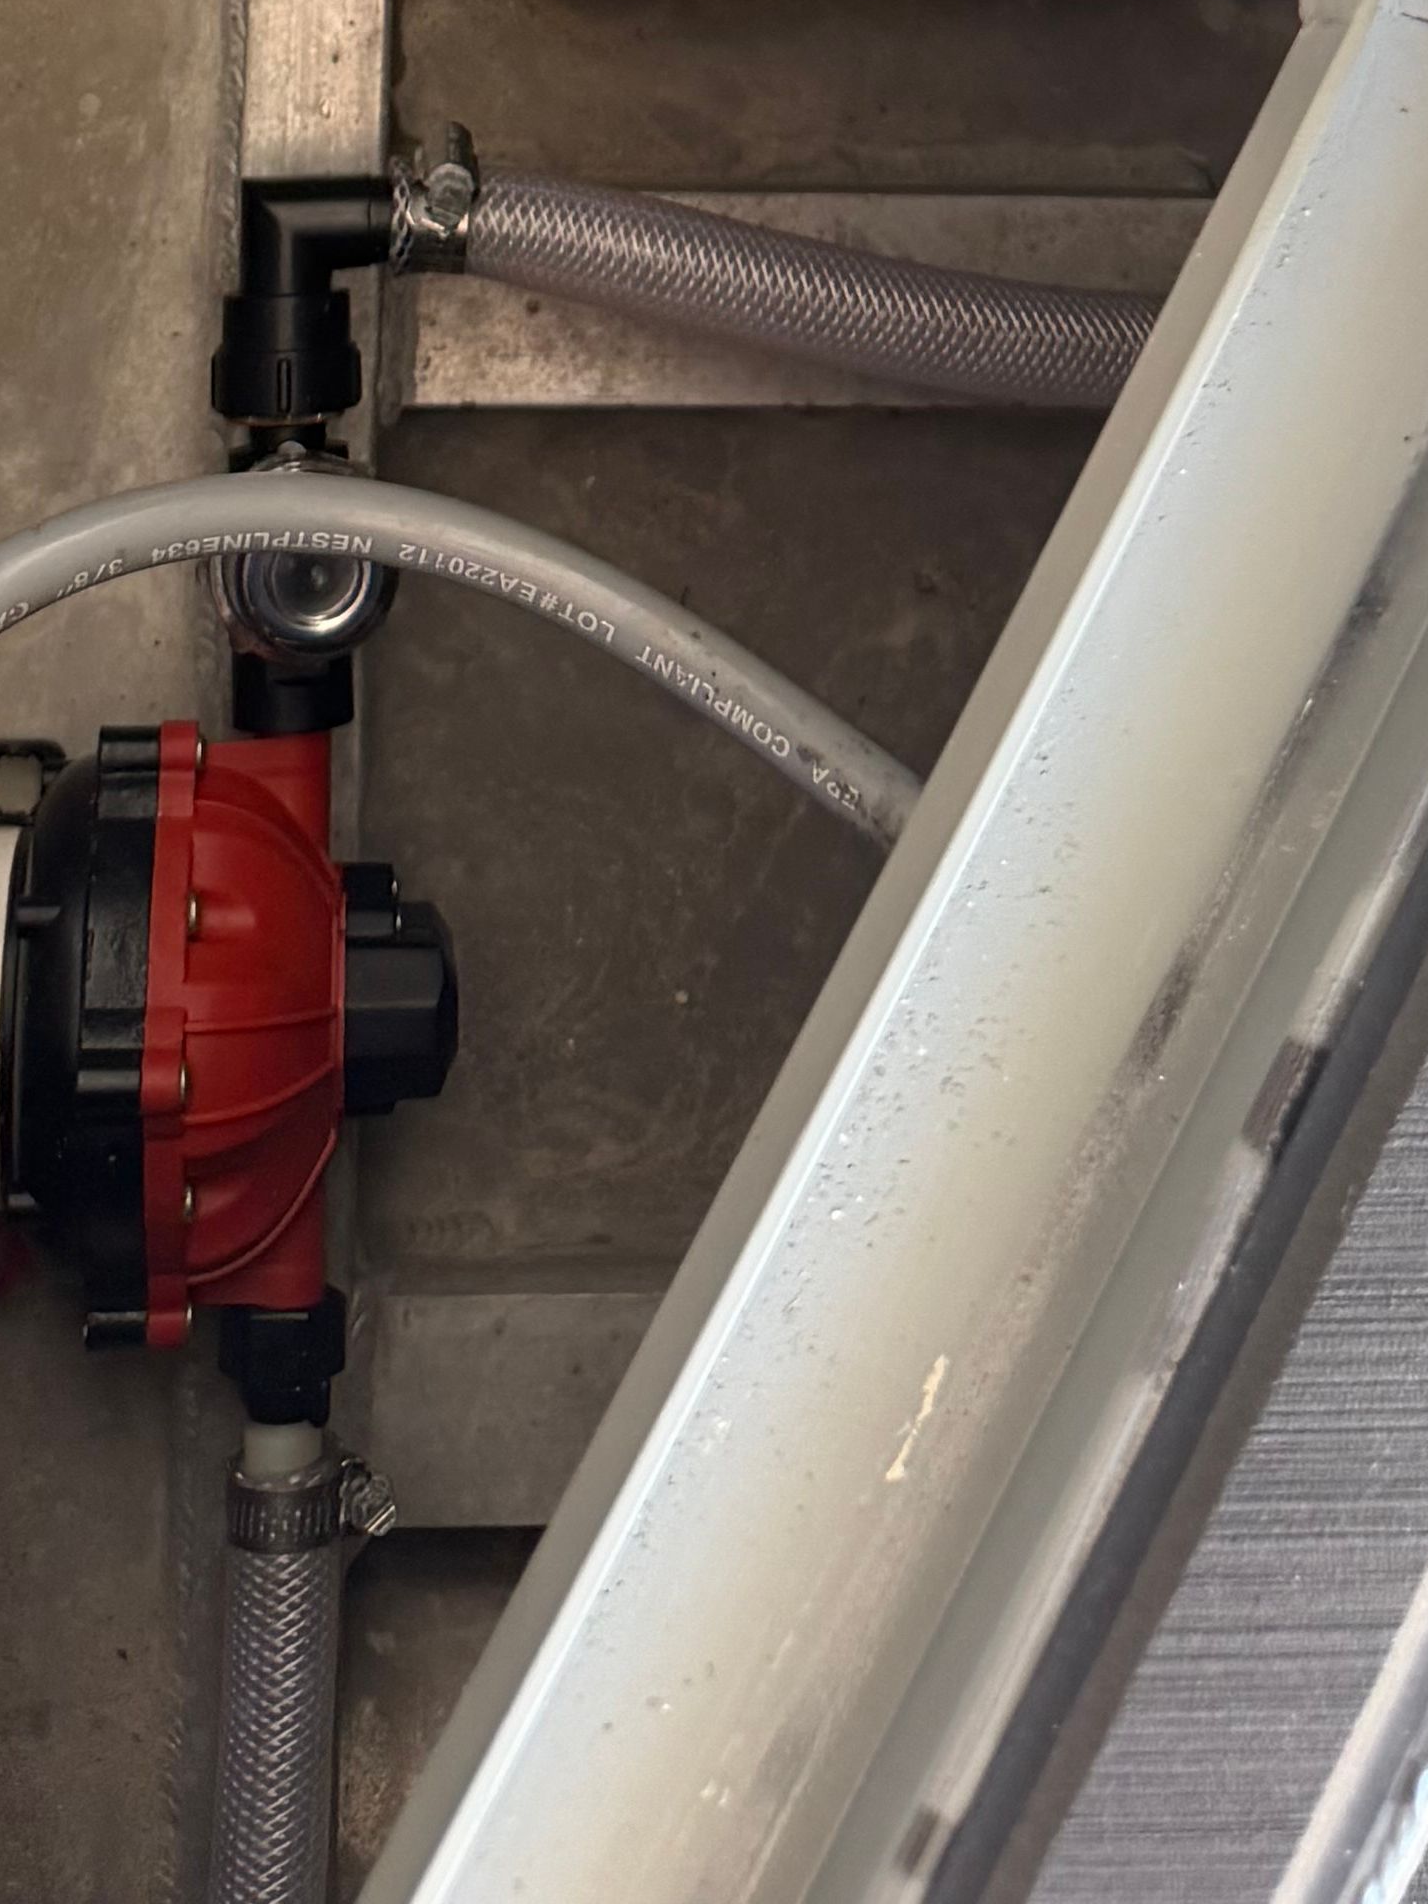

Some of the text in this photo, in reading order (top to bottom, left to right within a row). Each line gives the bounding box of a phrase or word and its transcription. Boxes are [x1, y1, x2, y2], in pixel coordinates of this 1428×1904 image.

[150, 530, 374, 564] NESTPLINE634
[396, 544, 617, 643] LOT#EA220112
[633, 645, 791, 758] COMPLIANT
